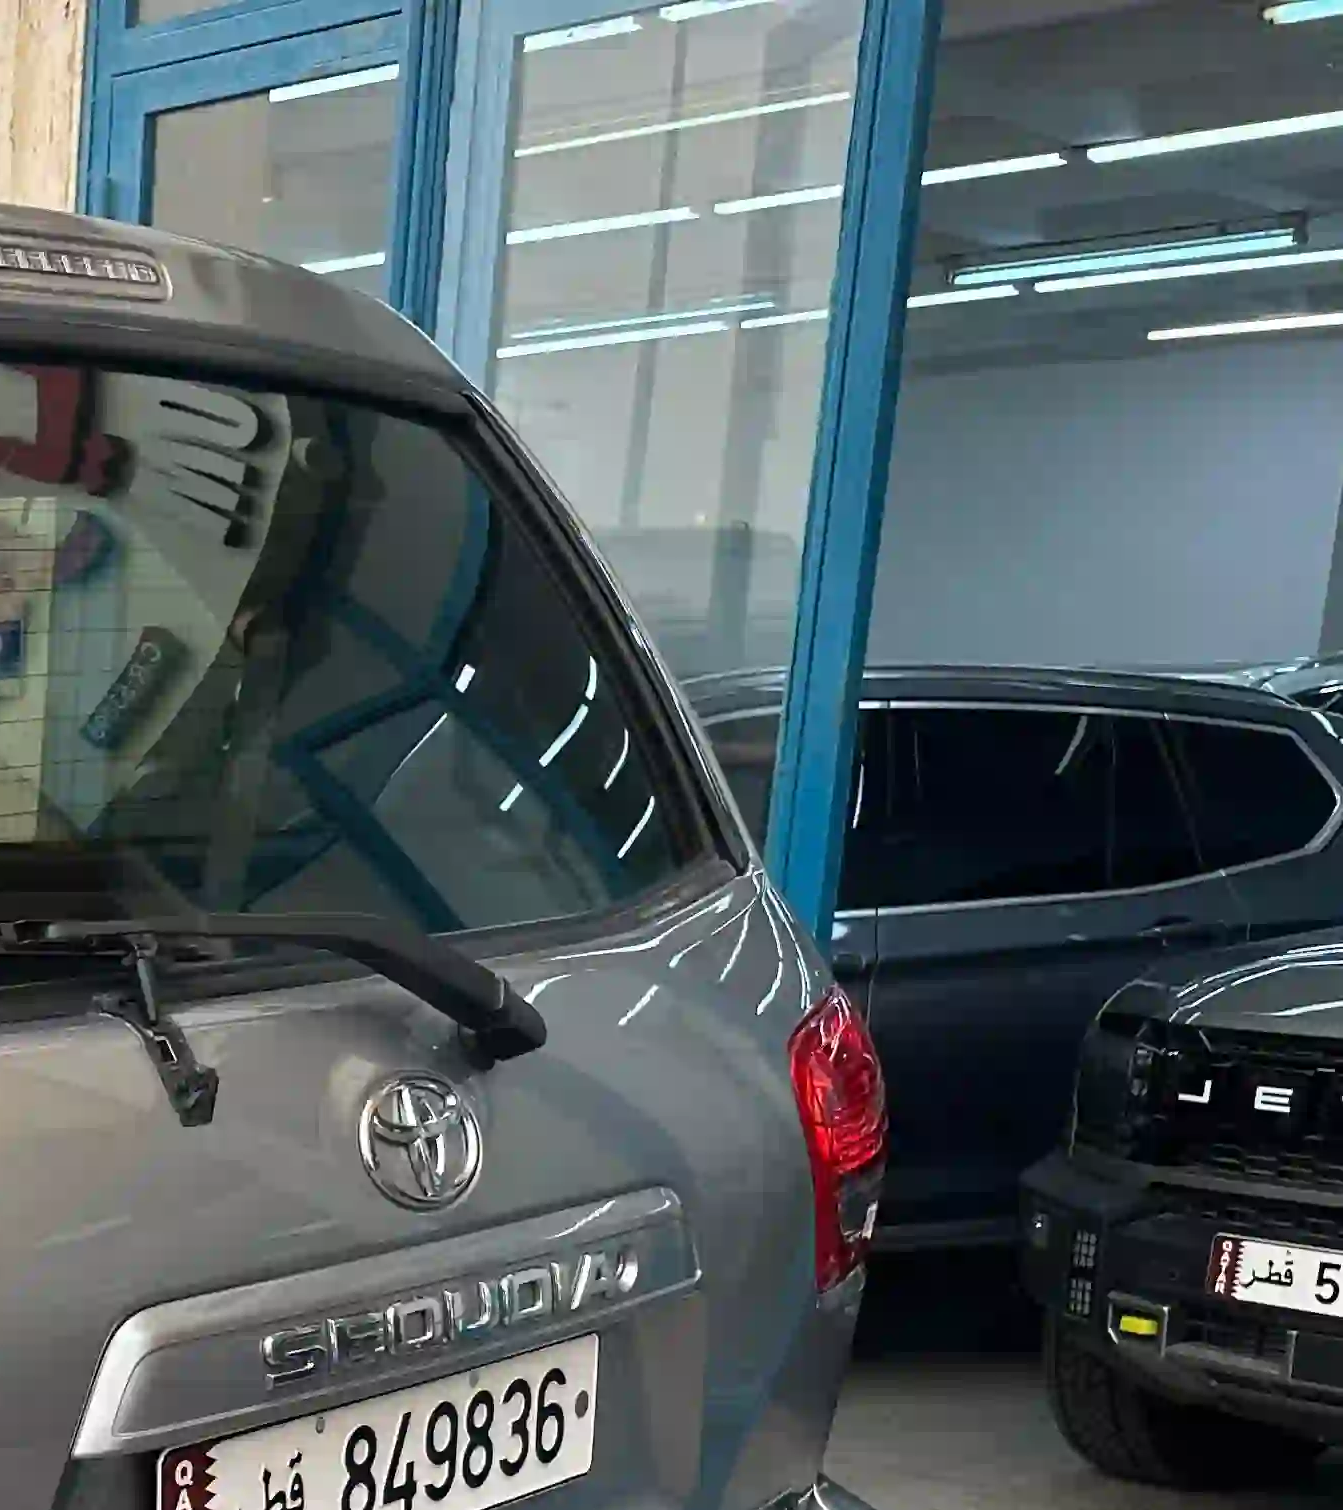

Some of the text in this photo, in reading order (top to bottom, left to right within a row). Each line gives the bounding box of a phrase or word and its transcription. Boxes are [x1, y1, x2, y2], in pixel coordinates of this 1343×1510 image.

[1214, 1240, 1233, 1294] QATAR
[1239, 1249, 1294, 1289] قطر
[259, 1252, 614, 1392] SEQUOIA
